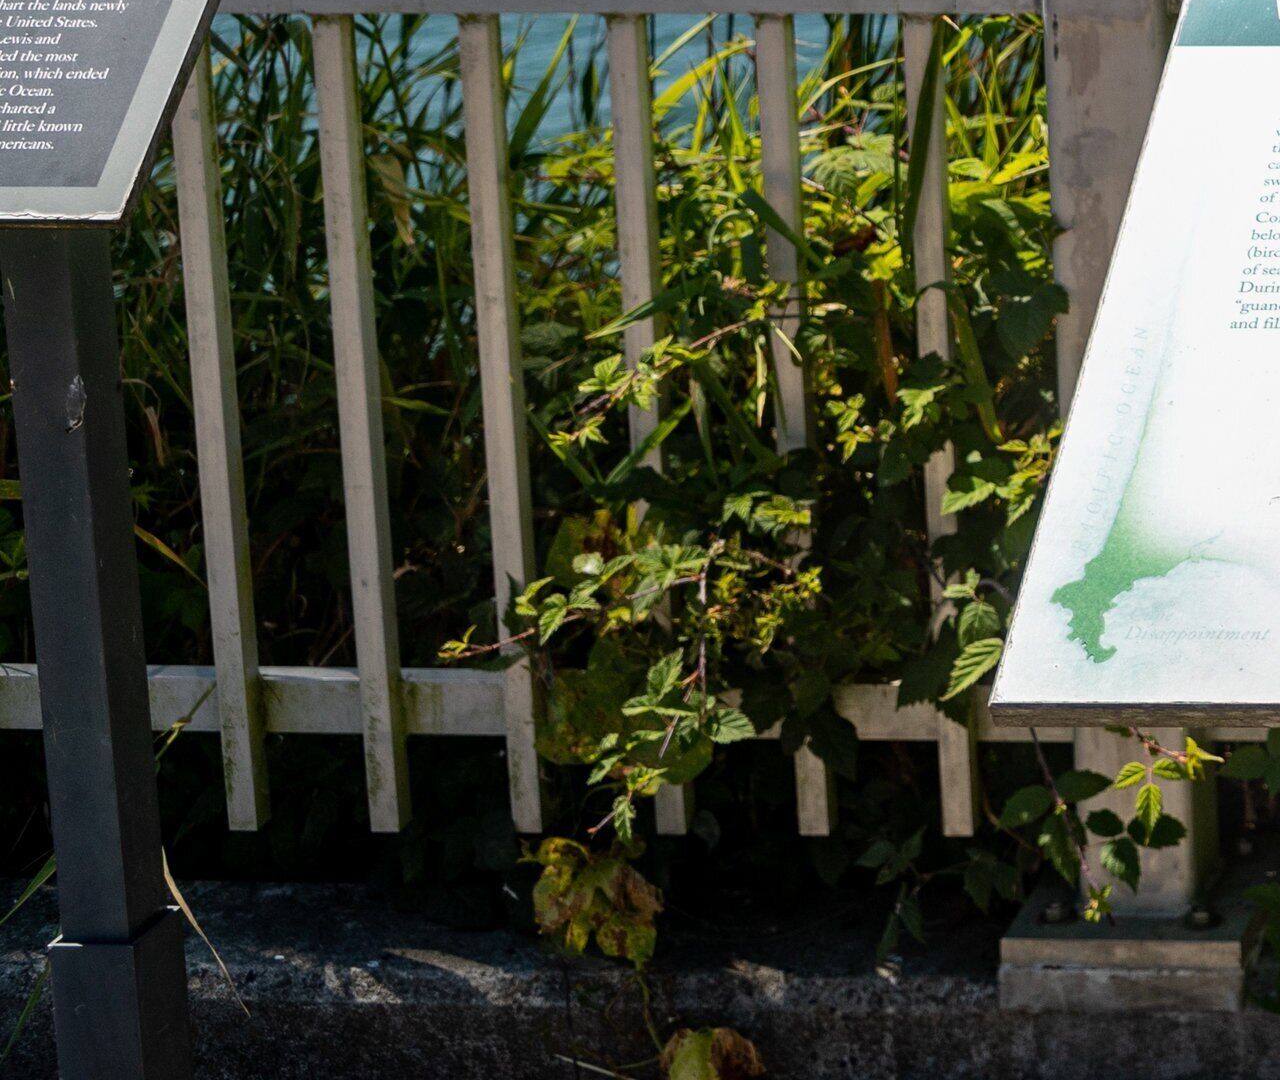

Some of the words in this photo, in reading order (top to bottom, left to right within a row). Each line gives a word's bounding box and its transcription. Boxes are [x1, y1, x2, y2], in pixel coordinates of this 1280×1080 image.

[27, 0, 50, 10] the
[52, 0, 86, 10] lands
[90, 0, 129, 13] newly
[6, 16, 53, 27] United
[54, 16, 98, 27] States.
[35, 33, 61, 44] and
[21, 50, 42, 61] the
[45, 53, 78, 62] most
[24, 67, 62, 79] which
[66, 68, 109, 79] ended
[9, 85, 54, 96] Ocean.
[47, 106, 55, 114] a
[2, 120, 35, 131] little
[38, 120, 83, 131] known
